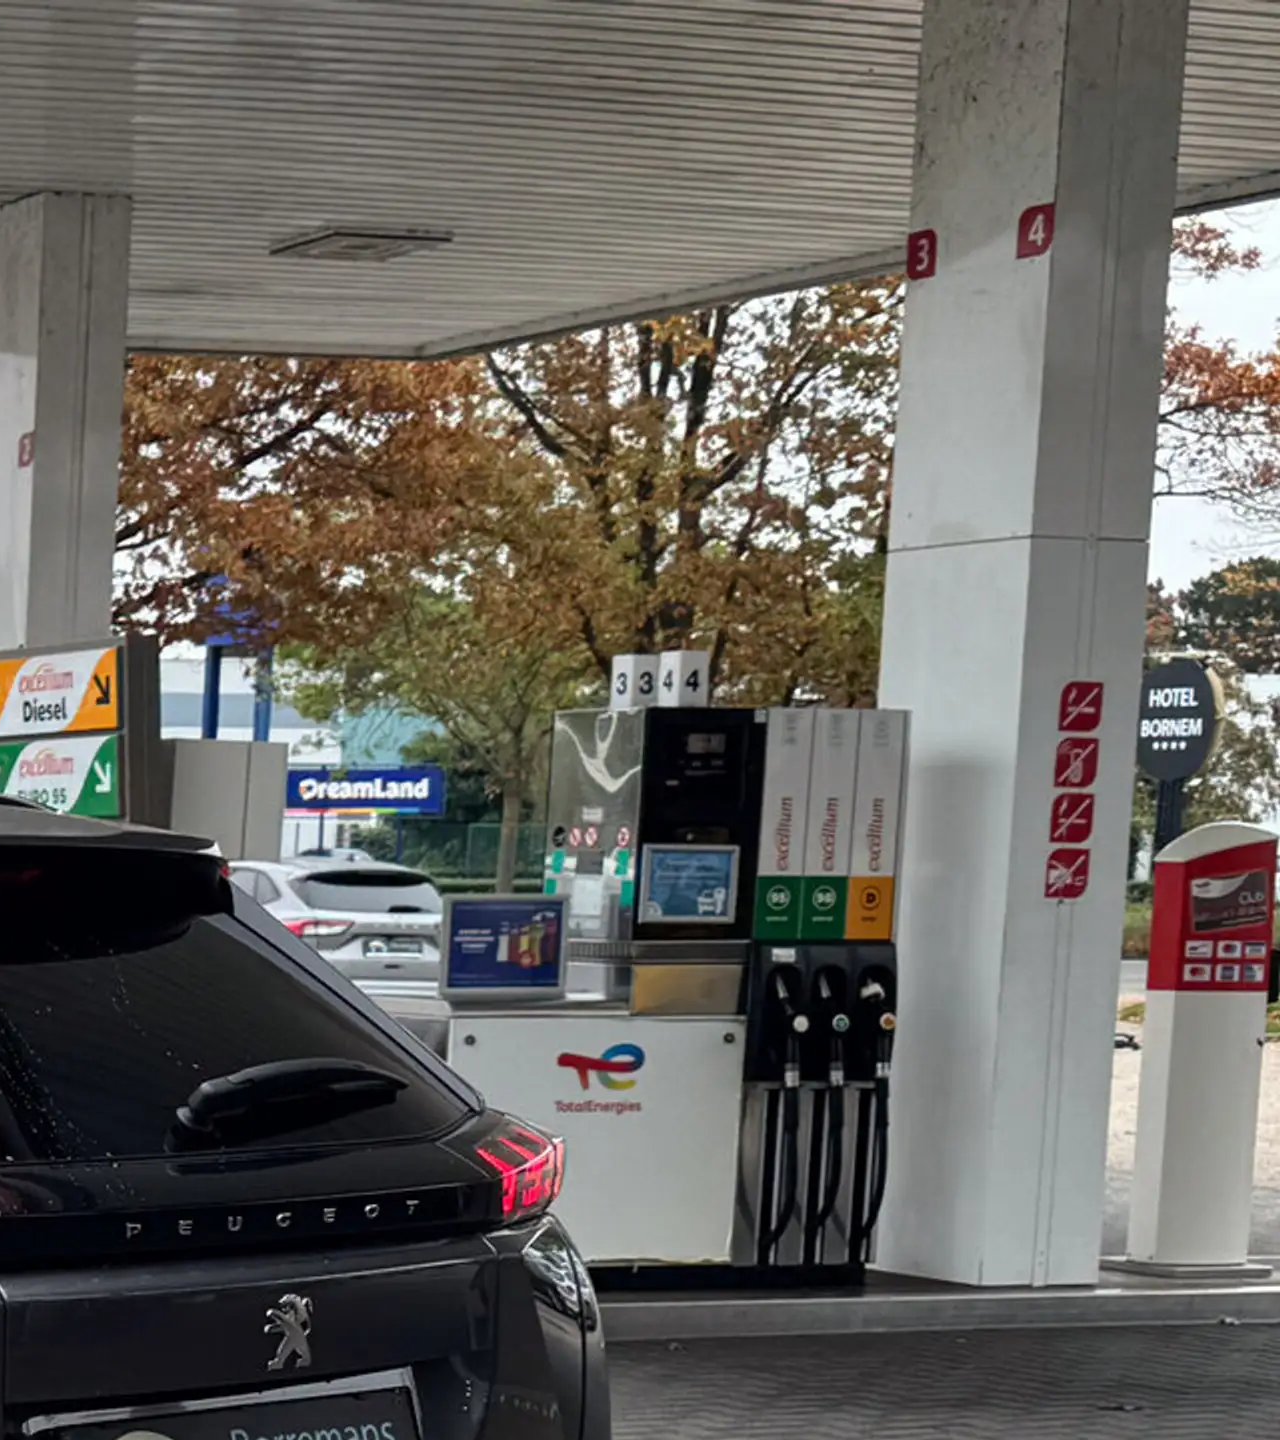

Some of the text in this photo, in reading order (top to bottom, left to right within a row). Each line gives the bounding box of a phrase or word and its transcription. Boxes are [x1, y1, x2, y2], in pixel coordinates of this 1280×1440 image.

[1028, 214, 1045, 247] 4
[915, 237, 929, 272] 3
[616, 671, 654, 695] 3 3
[662, 668, 700, 692] 4 4
[22, 696, 68, 723] Diesel
[1148, 687, 1200, 708] HOTEL
[1139, 717, 1204, 738] BORNEM
[298, 777, 430, 801] DreamLand
[554, 1099, 643, 1116] TotalEnergies
[125, 1199, 421, 1240] PEUGEOT
